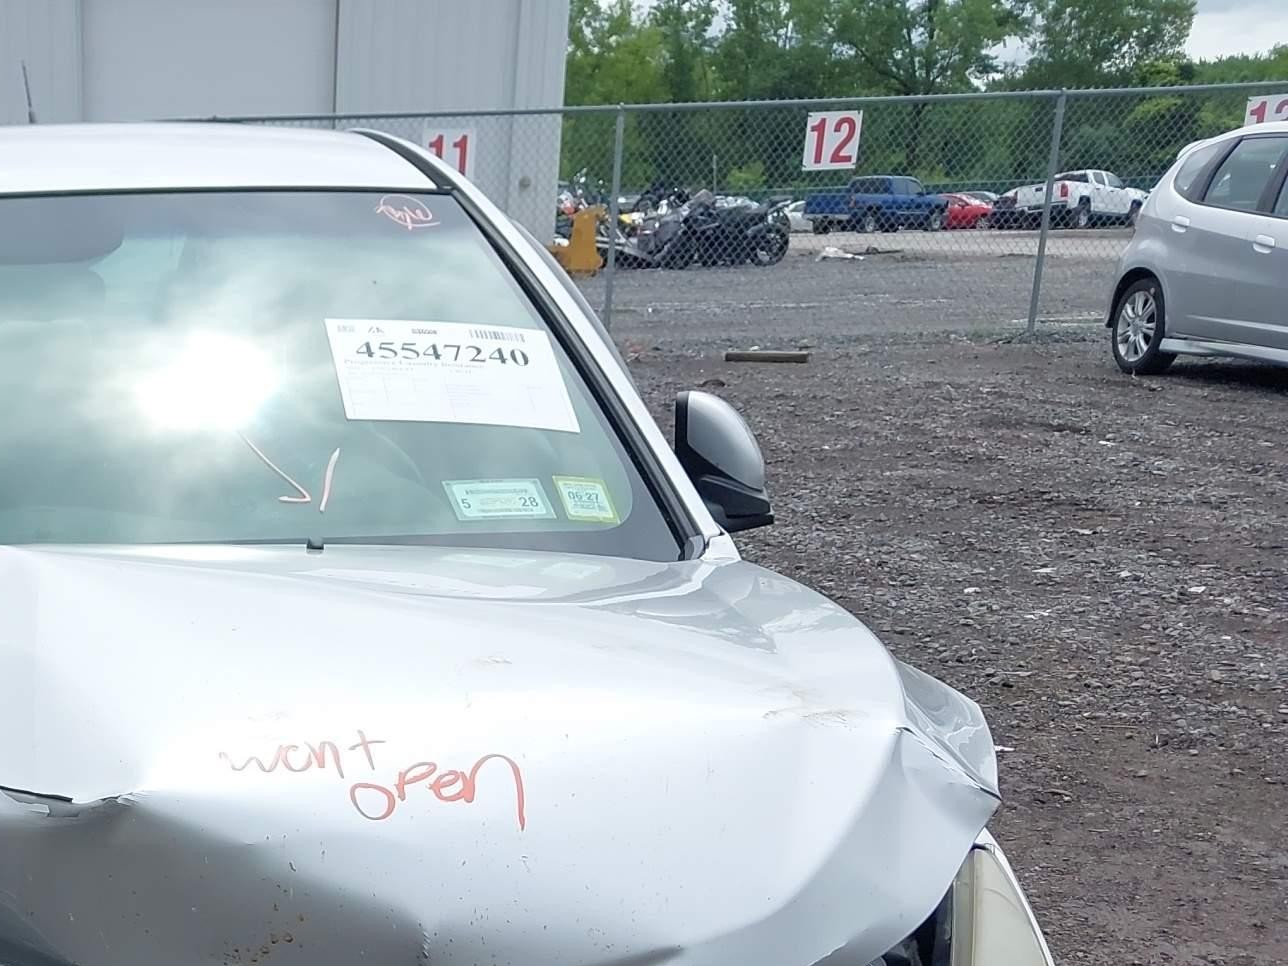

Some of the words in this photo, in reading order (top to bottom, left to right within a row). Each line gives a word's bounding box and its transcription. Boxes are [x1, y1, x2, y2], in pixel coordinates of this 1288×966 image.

[1250, 100, 1288, 124] 1
[810, 116, 856, 164] 12
[428, 134, 469, 176] 11
[356, 341, 529, 367] 45547240
[462, 498, 472, 509] 5
[518, 496, 539, 507] 28
